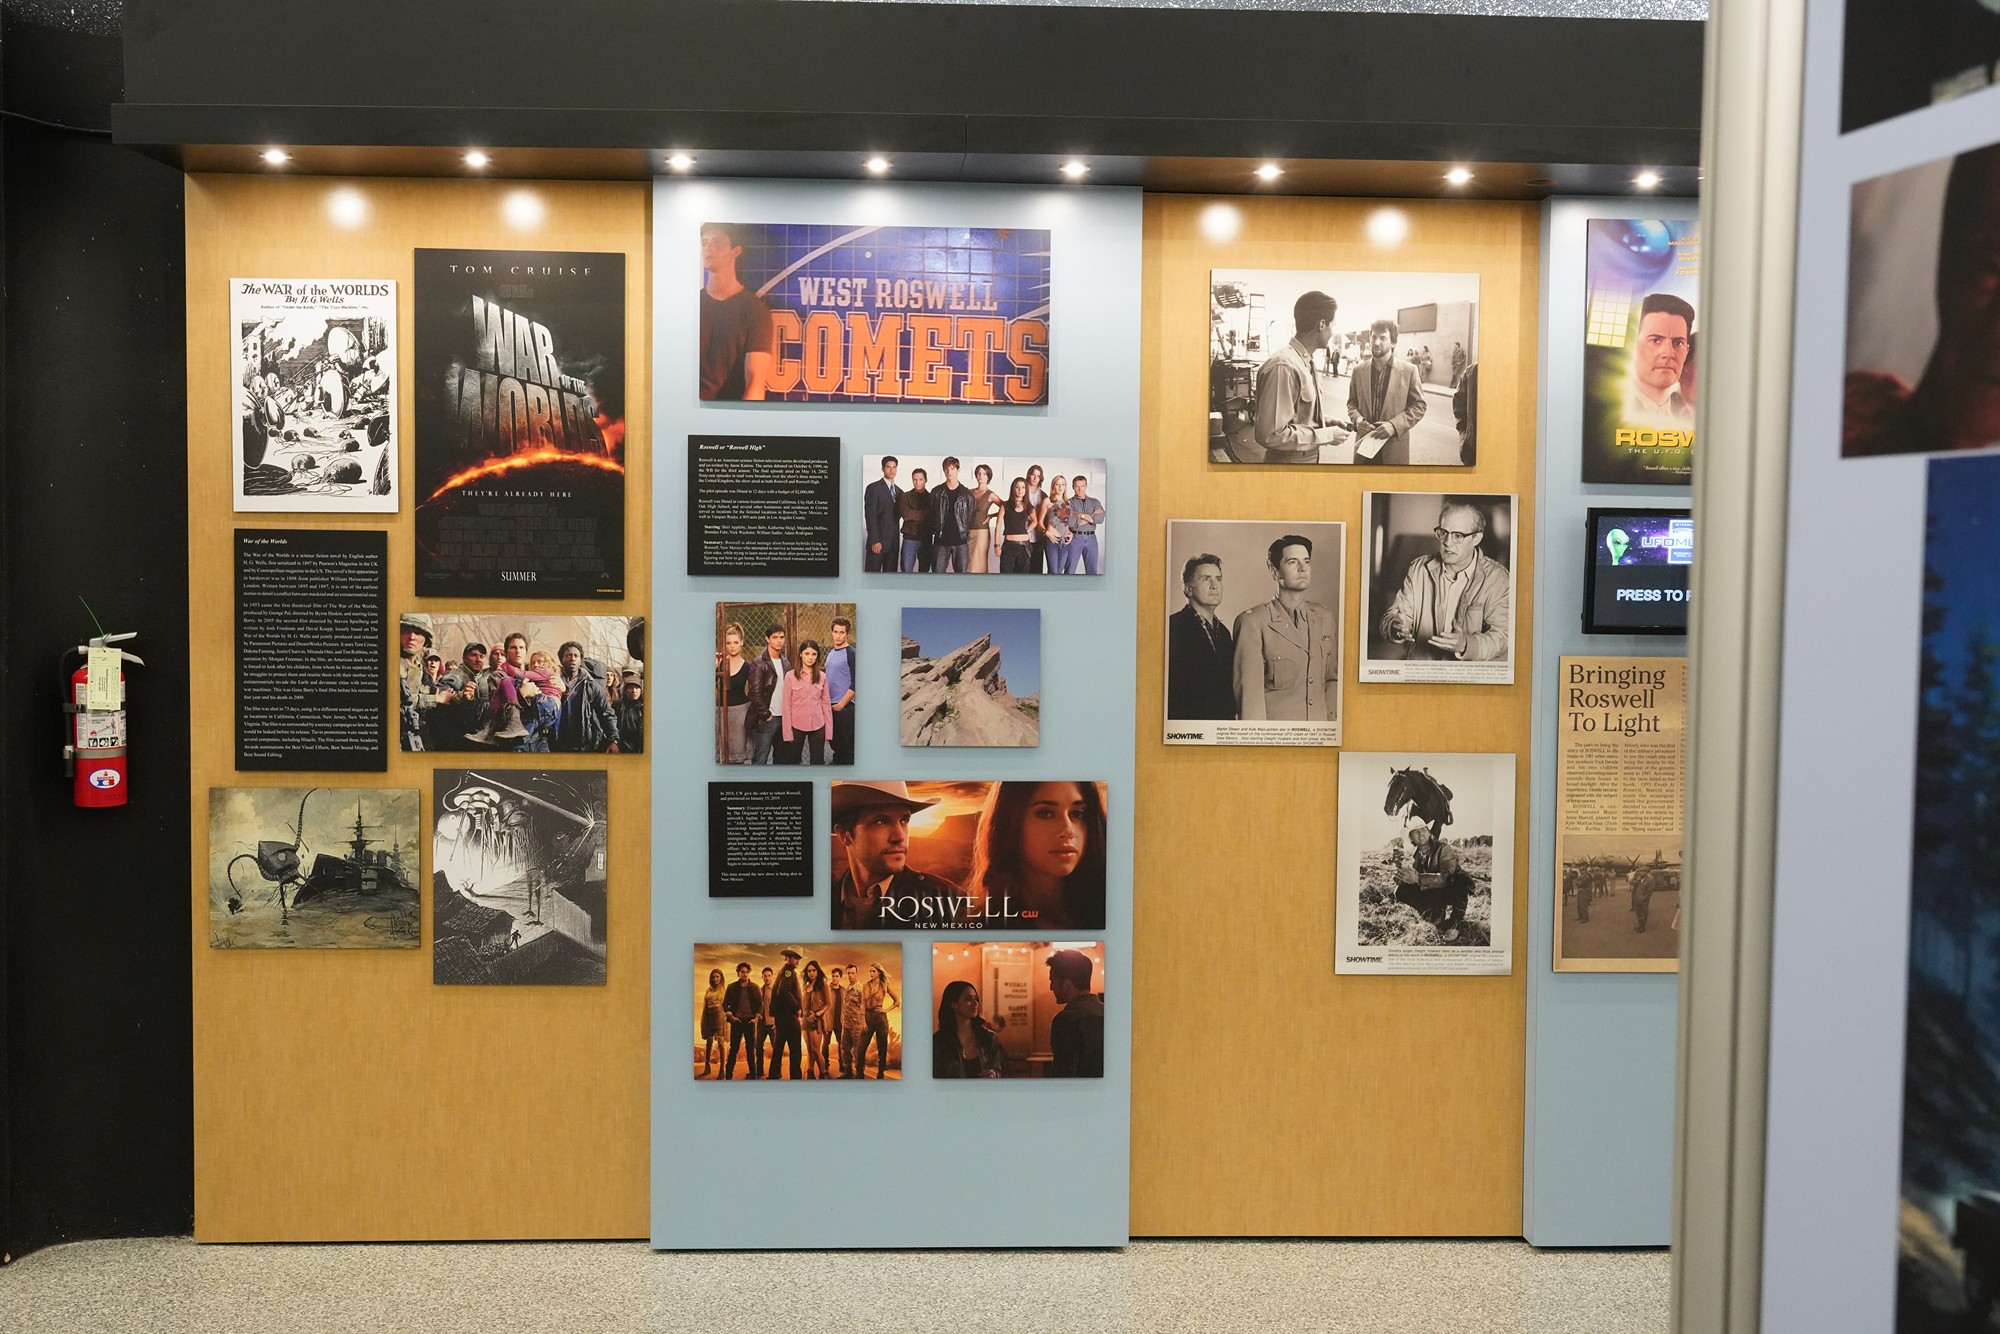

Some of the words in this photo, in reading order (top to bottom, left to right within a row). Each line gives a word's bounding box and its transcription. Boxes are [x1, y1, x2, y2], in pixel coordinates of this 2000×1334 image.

[450, 265, 493, 274] TOM
[511, 266, 592, 276] CRUISE
[241, 284, 261, 295] The
[262, 284, 292, 295] WAR
[297, 285, 307, 295] of
[310, 285, 327, 295] the
[330, 285, 388, 296] WORLDS
[285, 296, 297, 304] By
[798, 277, 867, 307] WEST
[875, 279, 997, 311] ROSWELL
[472, 295, 561, 388] WAR
[765, 310, 1048, 403] COMETS
[572, 377, 586, 394] THE
[446, 363, 608, 456] WORLDS
[1615, 429, 1696, 447] ROSW
[501, 571, 537, 582] SUMMER
[1617, 589, 1661, 600] PRESS
[1664, 590, 1683, 601] TO
[1569, 664, 1665, 689] Bringing
[1569, 688, 1654, 708] Roswell
[1568, 712, 1596, 732] To
[1604, 713, 1660, 737] Light
[878, 896, 1019, 922] ROSWELL
